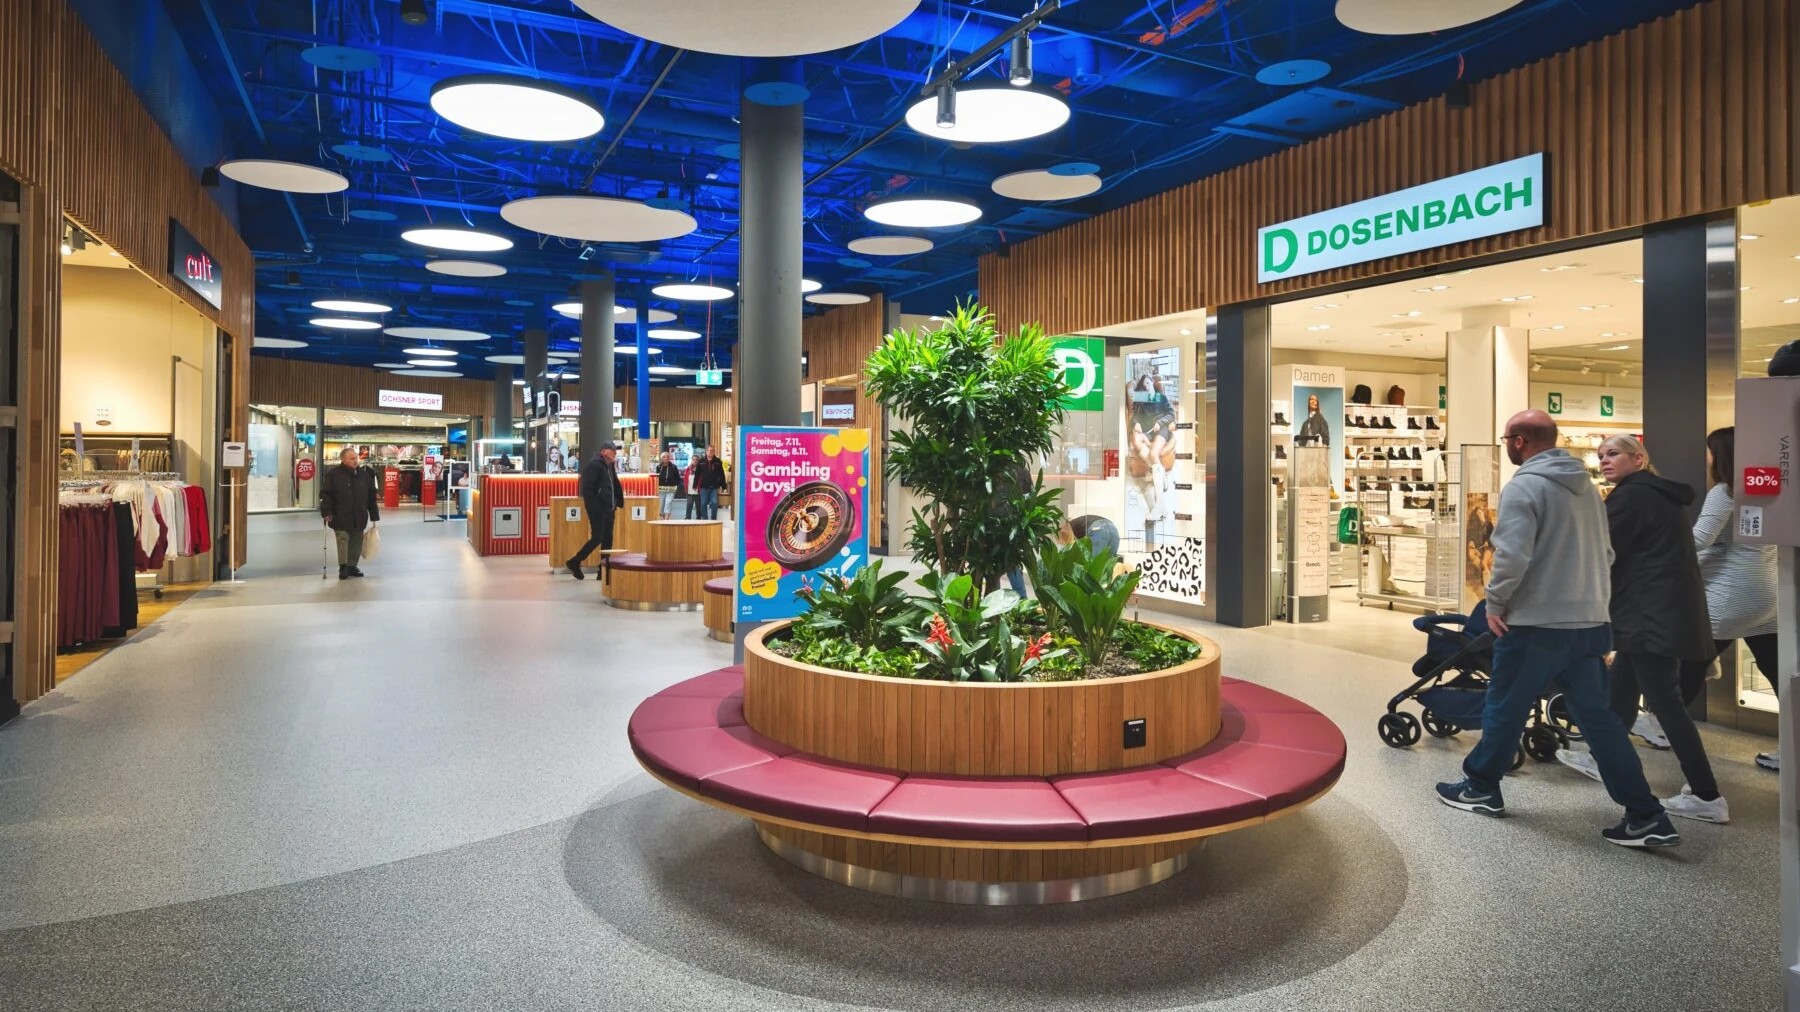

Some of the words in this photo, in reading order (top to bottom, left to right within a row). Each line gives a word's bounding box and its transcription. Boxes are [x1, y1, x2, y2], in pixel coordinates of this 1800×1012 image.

[1308, 177, 1532, 256] DOSENBACH
[186, 252, 213, 283] cult
[1294, 368, 1336, 384] Damen
[381, 395, 416, 404] OCHSNER
[418, 397, 440, 406] SPORT
[751, 437, 784, 447] Freitag,
[785, 438, 802, 446] 7.11.
[750, 446, 791, 457] Samstag,
[791, 447, 809, 456] 8.11.
[1779, 435, 1790, 487] VARESE
[750, 461, 831, 481] Gambling
[750, 477, 796, 497] Days!
[1746, 474, 1778, 487] 30%
